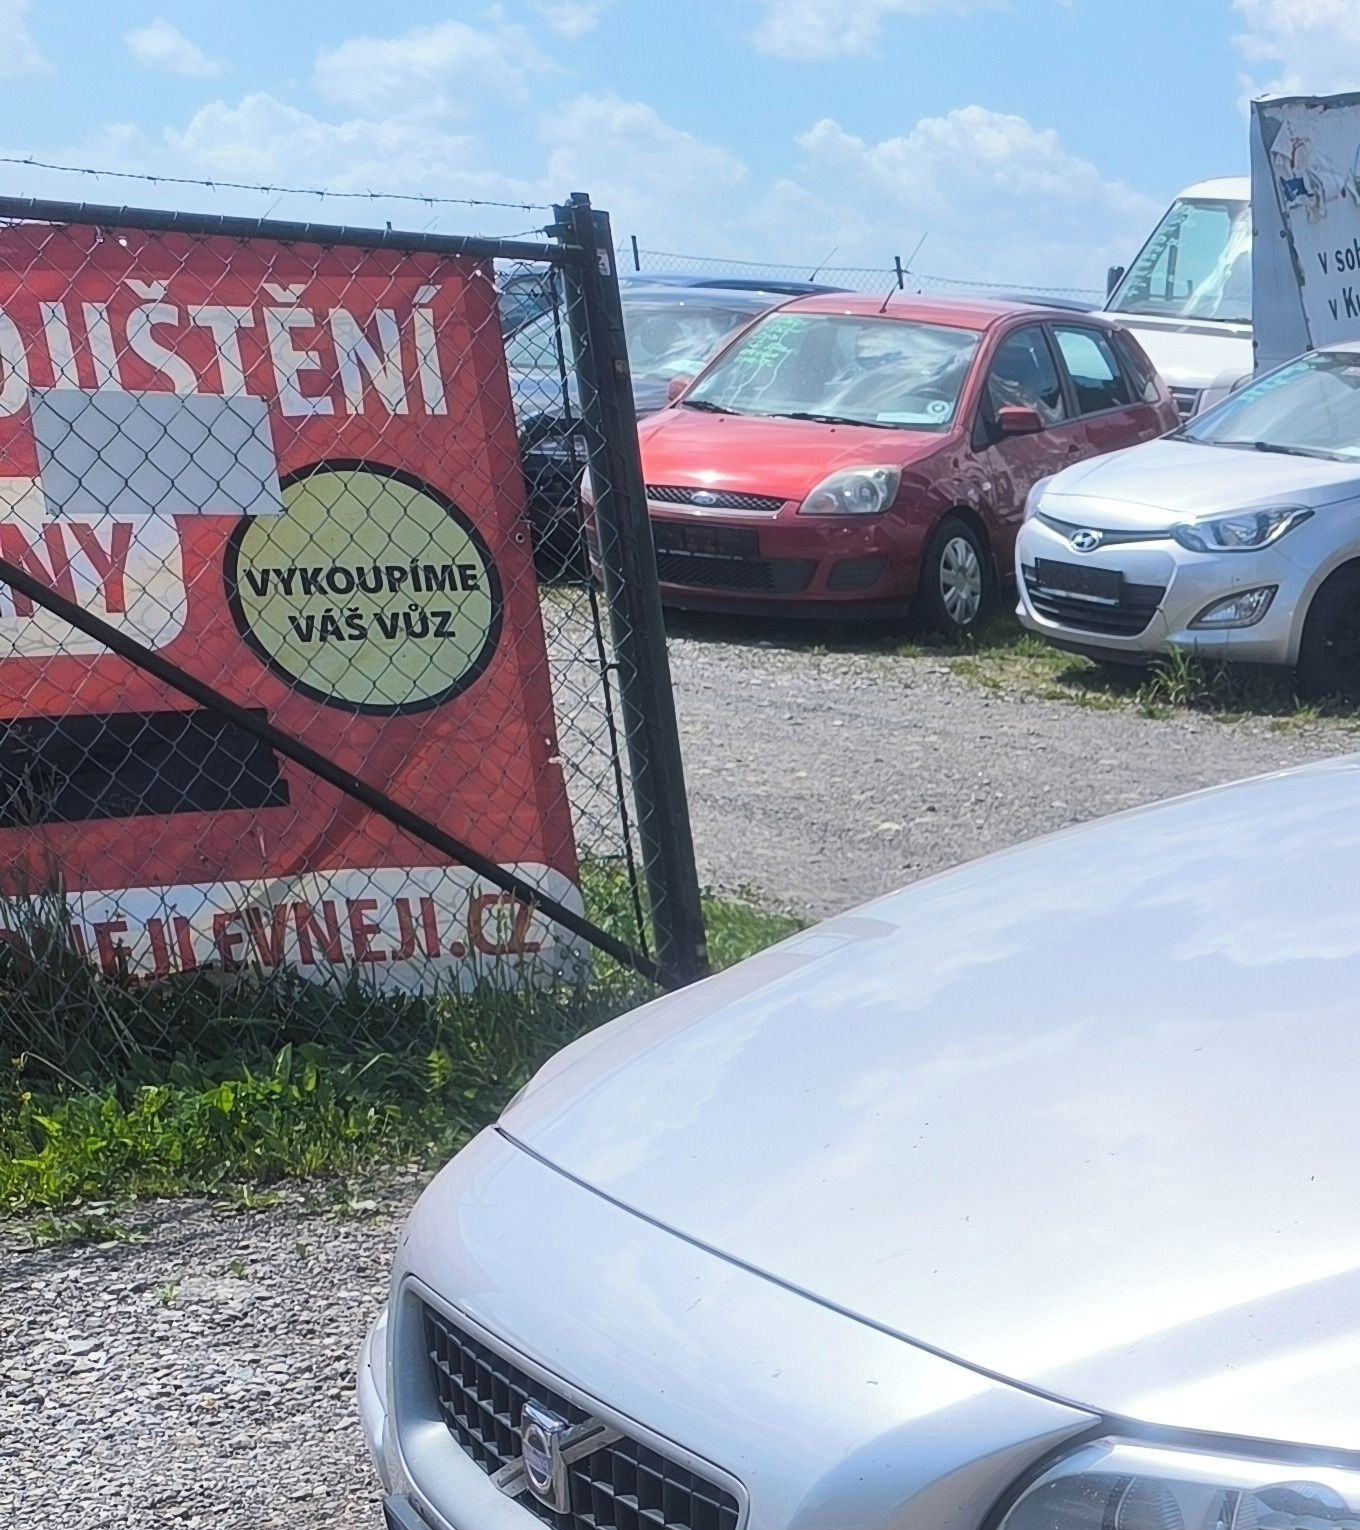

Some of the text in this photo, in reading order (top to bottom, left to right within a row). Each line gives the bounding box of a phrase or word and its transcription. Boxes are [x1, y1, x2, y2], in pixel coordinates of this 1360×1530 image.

[1318, 251, 1327, 275] v
[1328, 298, 1337, 320] v
[243, 558, 480, 597] VYKOUPÍME
[288, 603, 456, 643] VÁŠ VŮZ
